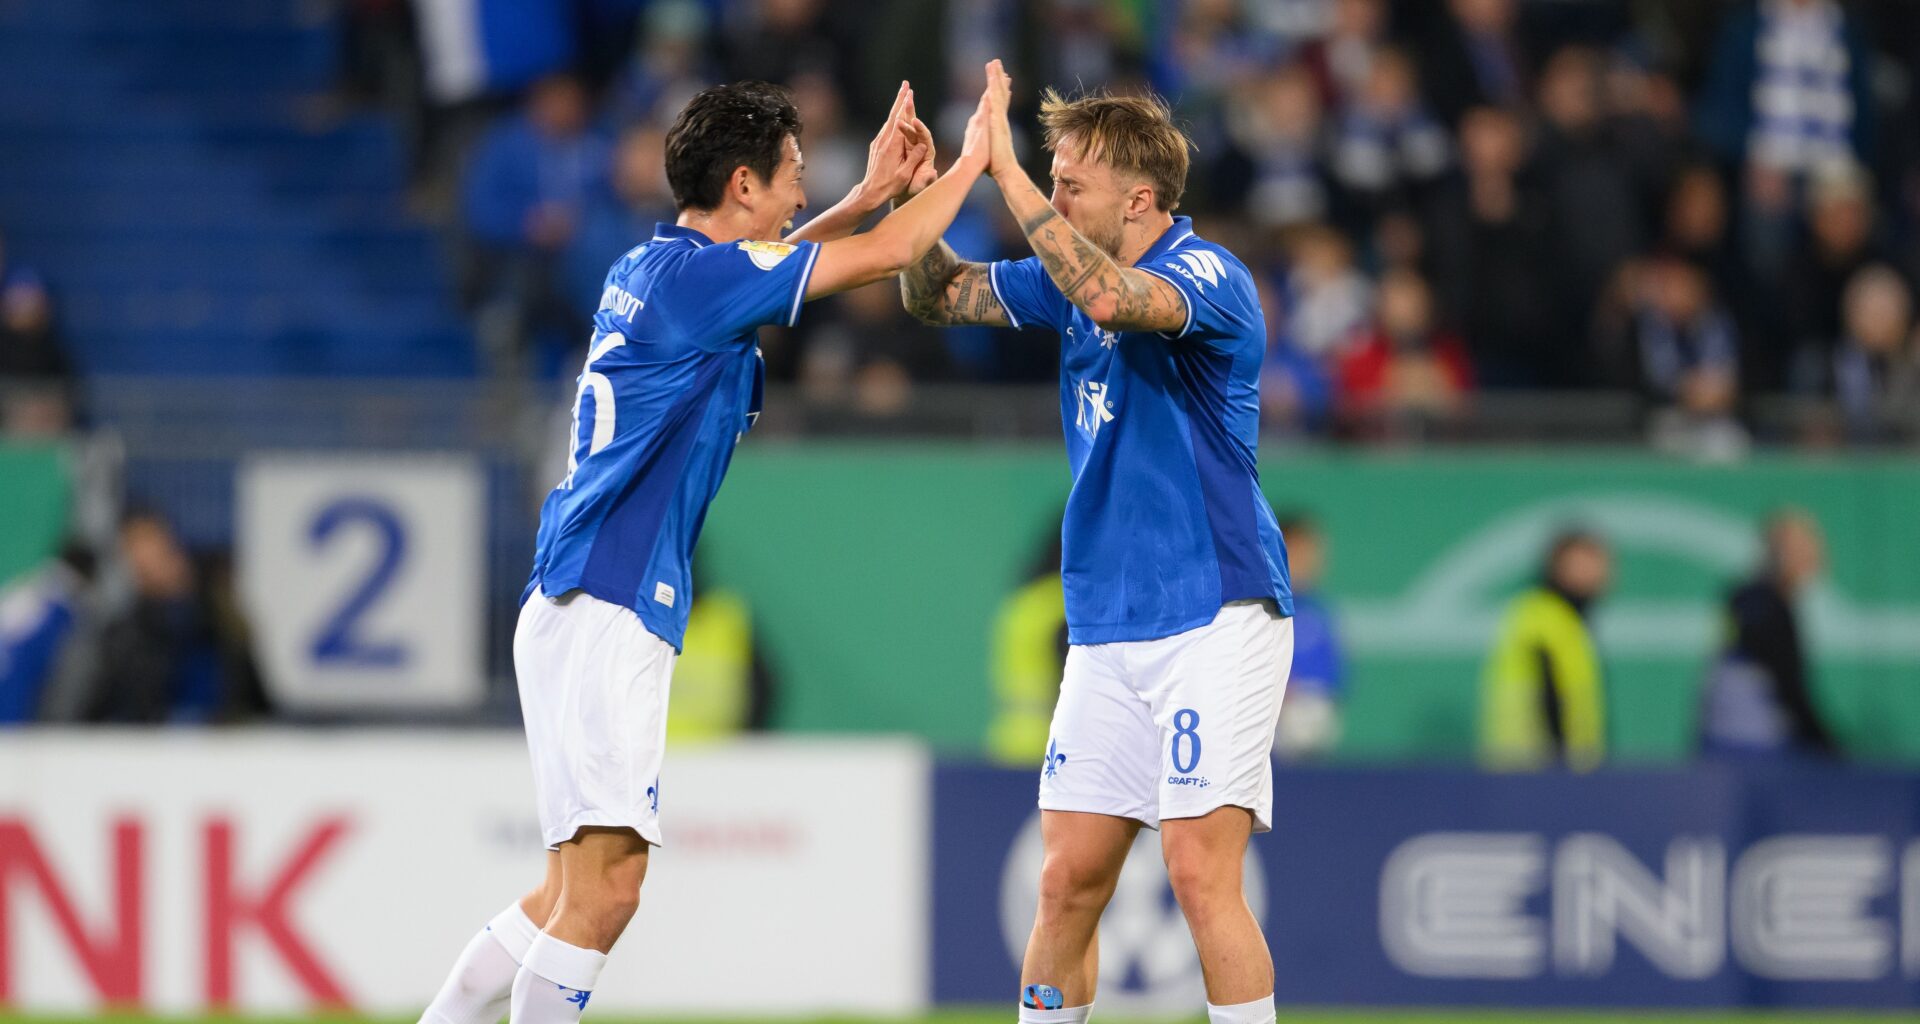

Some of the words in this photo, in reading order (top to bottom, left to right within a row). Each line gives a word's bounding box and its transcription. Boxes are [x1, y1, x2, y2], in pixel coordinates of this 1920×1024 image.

[567, 326, 627, 468] 6
[308, 496, 410, 669] 2
[1167, 776, 1200, 786] CRAFT
[1171, 708, 1202, 774] 8
[0, 815, 352, 1009] NK
[1379, 830, 1920, 980] ENE
